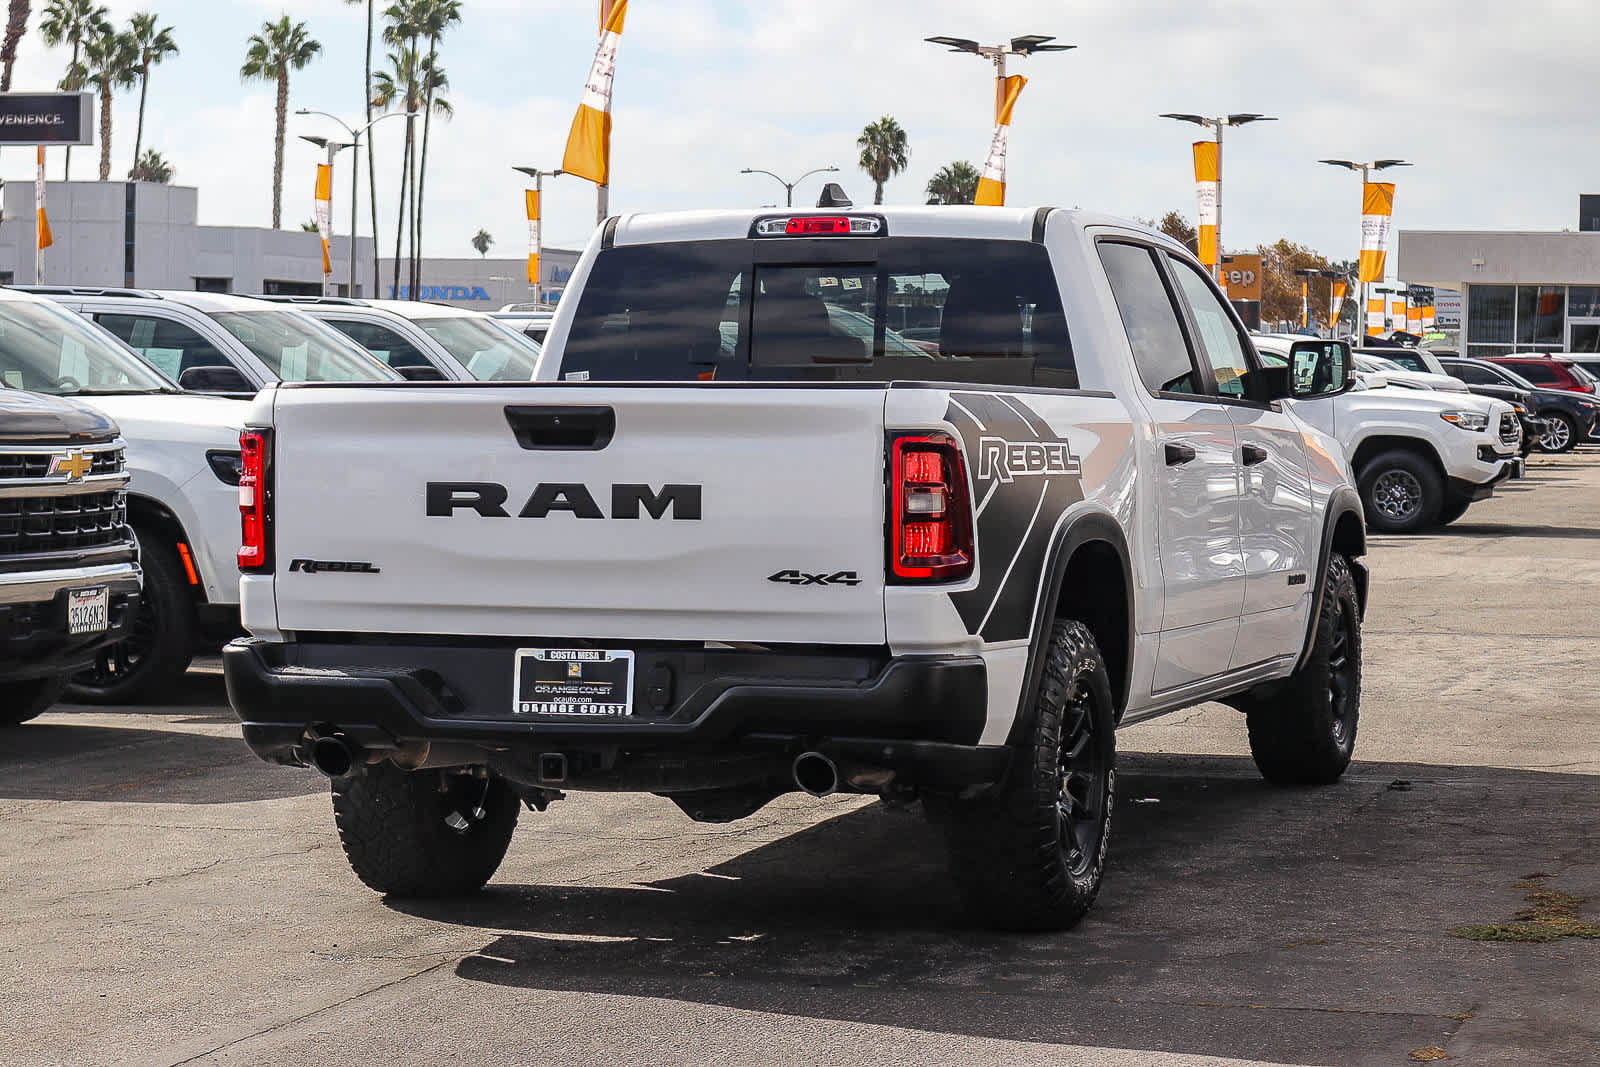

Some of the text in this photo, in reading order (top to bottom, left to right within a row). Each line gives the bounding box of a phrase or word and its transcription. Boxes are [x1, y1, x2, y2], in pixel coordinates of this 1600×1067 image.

[977, 436, 1081, 483] REBEL
[426, 481, 702, 520] RAM
[767, 570, 863, 586] 4x4
[550, 651, 600, 660] COSTA MESA
[553, 696, 593, 704] ocauto.com
[522, 703, 625, 714] ORANGE COAST
